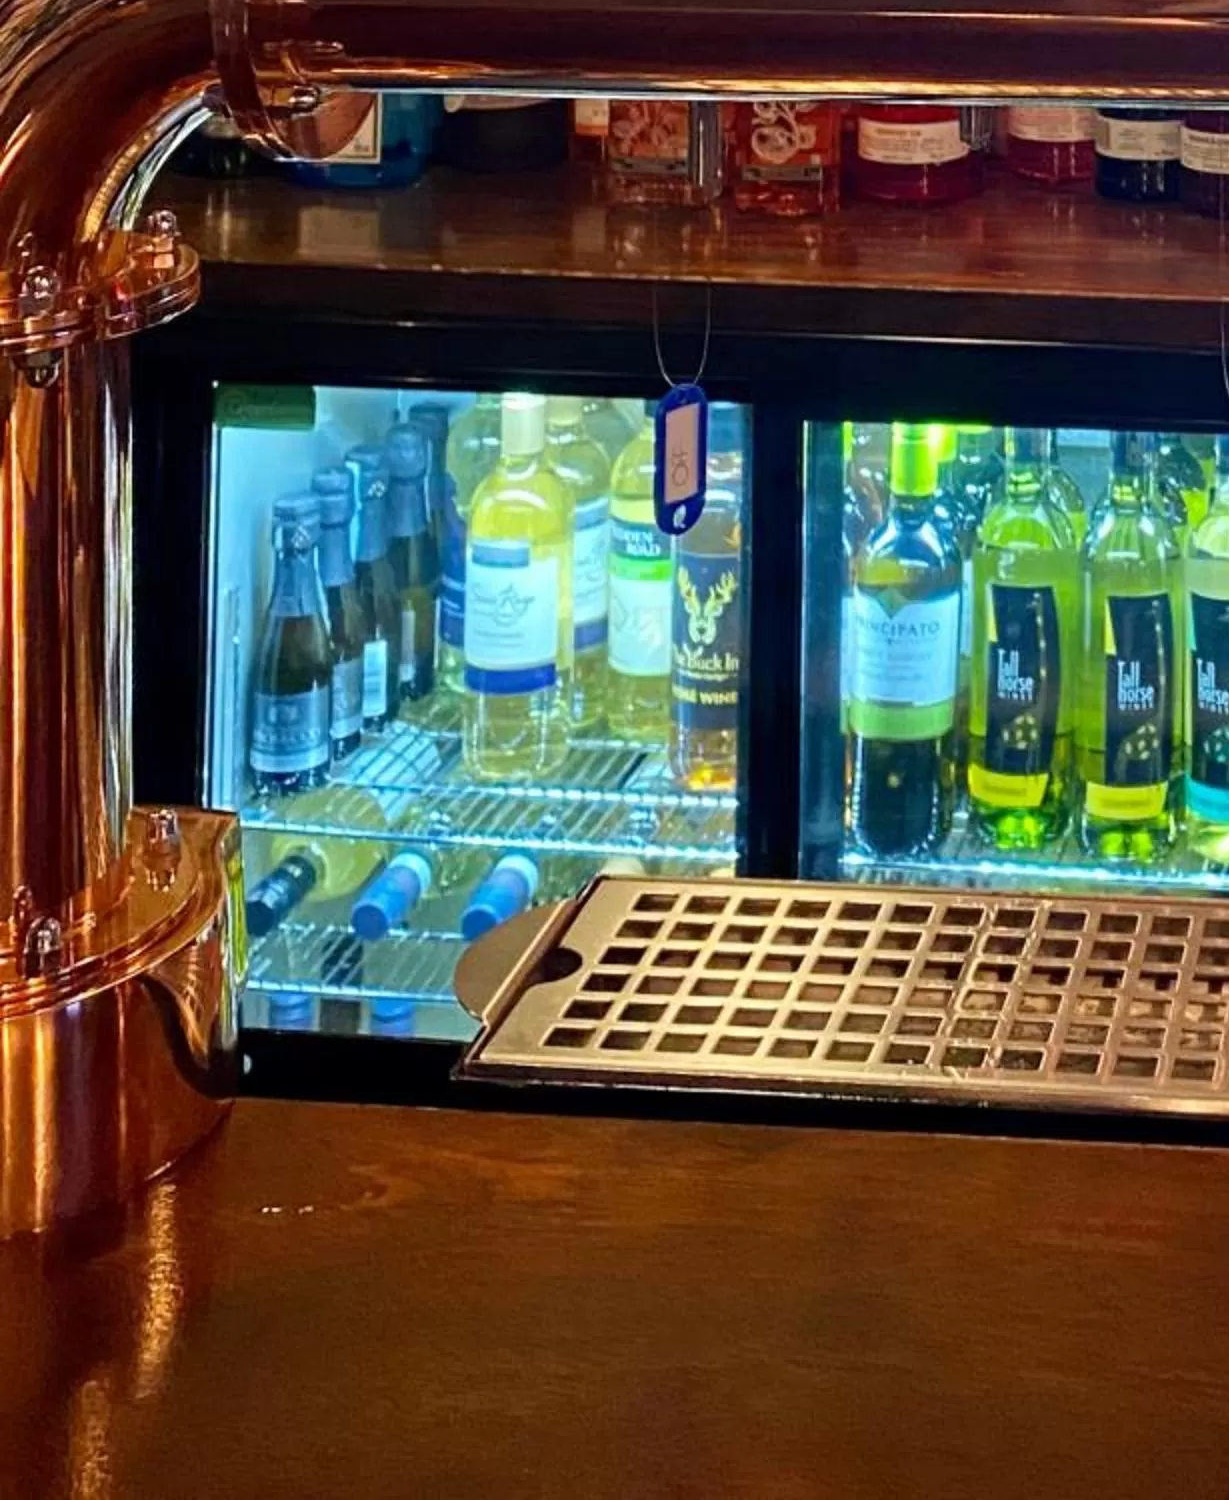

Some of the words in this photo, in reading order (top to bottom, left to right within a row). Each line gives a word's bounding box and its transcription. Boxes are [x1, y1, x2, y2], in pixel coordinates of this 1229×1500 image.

[997, 648, 1020, 678] Tall
[1117, 660, 1141, 688] Tall
[998, 674, 1035, 693] horse
[1118, 684, 1155, 703] horse
